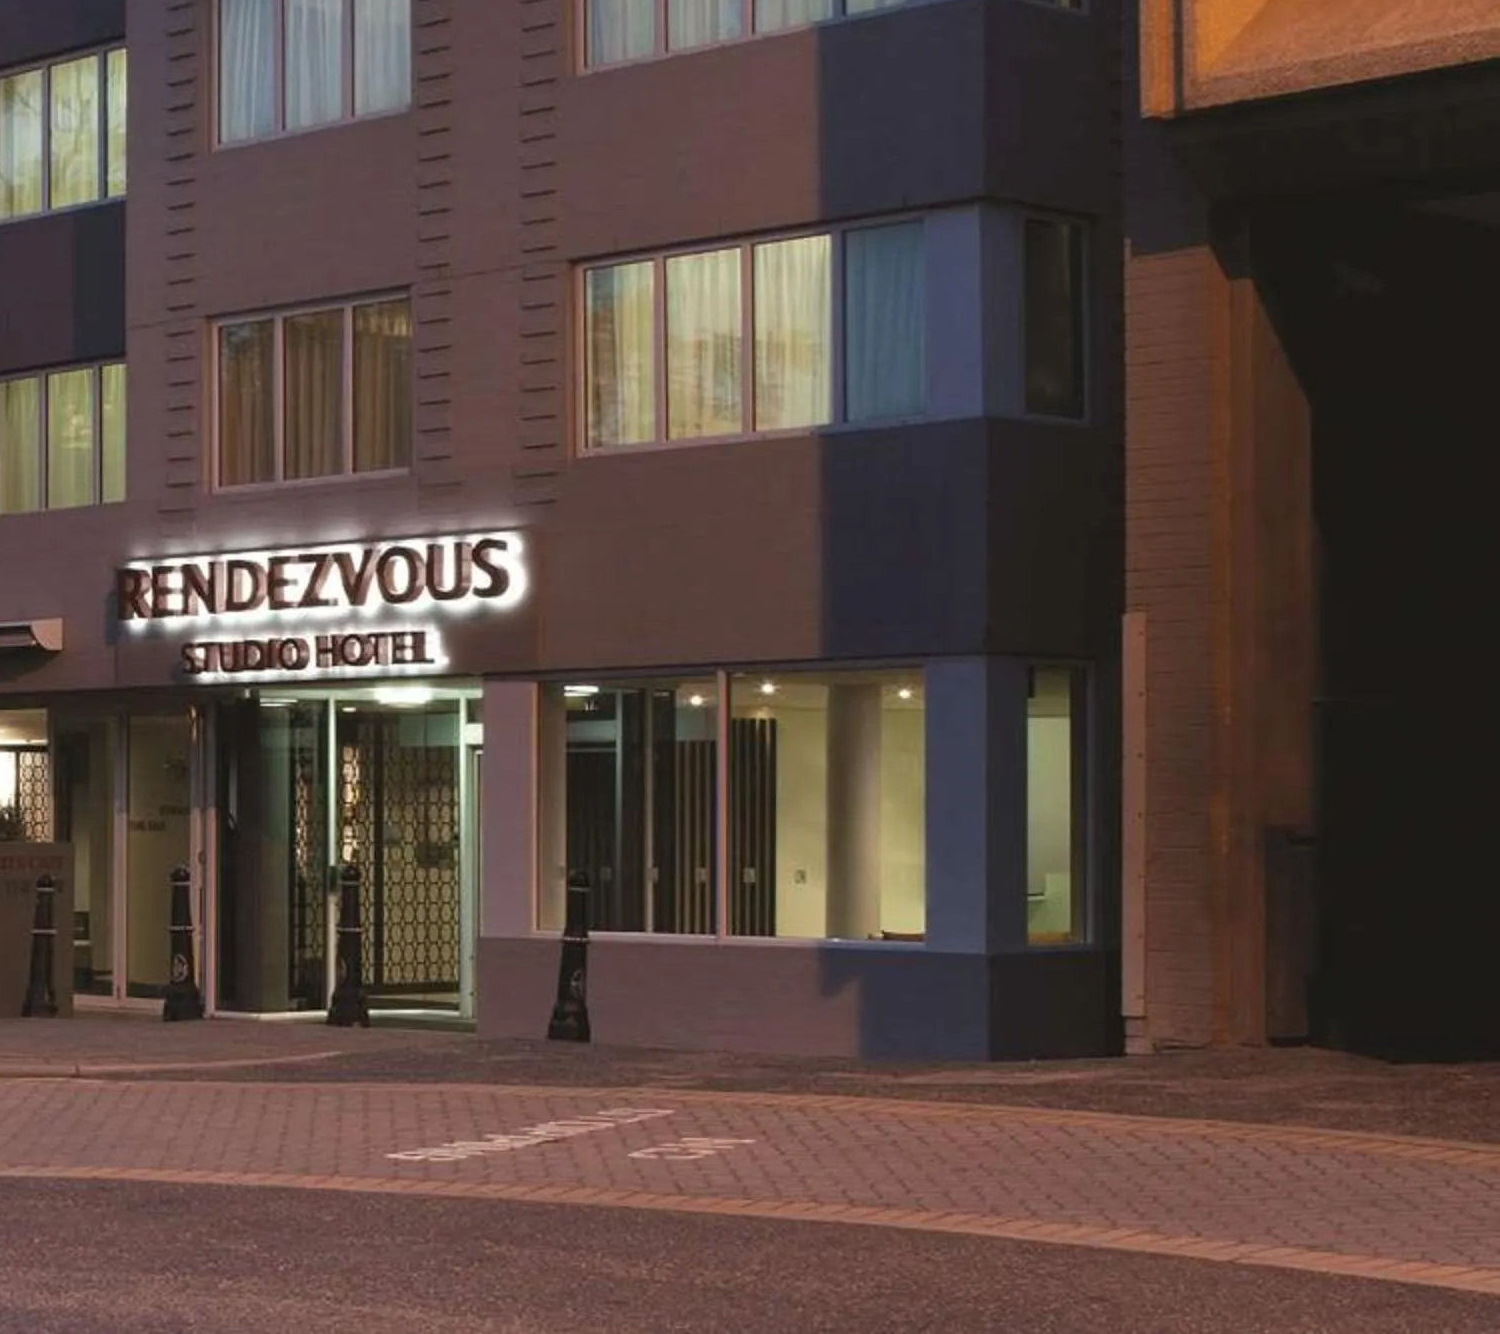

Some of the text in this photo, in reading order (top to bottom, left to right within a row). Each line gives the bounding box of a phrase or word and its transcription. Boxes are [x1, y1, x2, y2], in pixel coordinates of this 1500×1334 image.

[116, 539, 511, 621] RENDEZVOUS
[181, 631, 435, 675] STUDIO HOTEL
